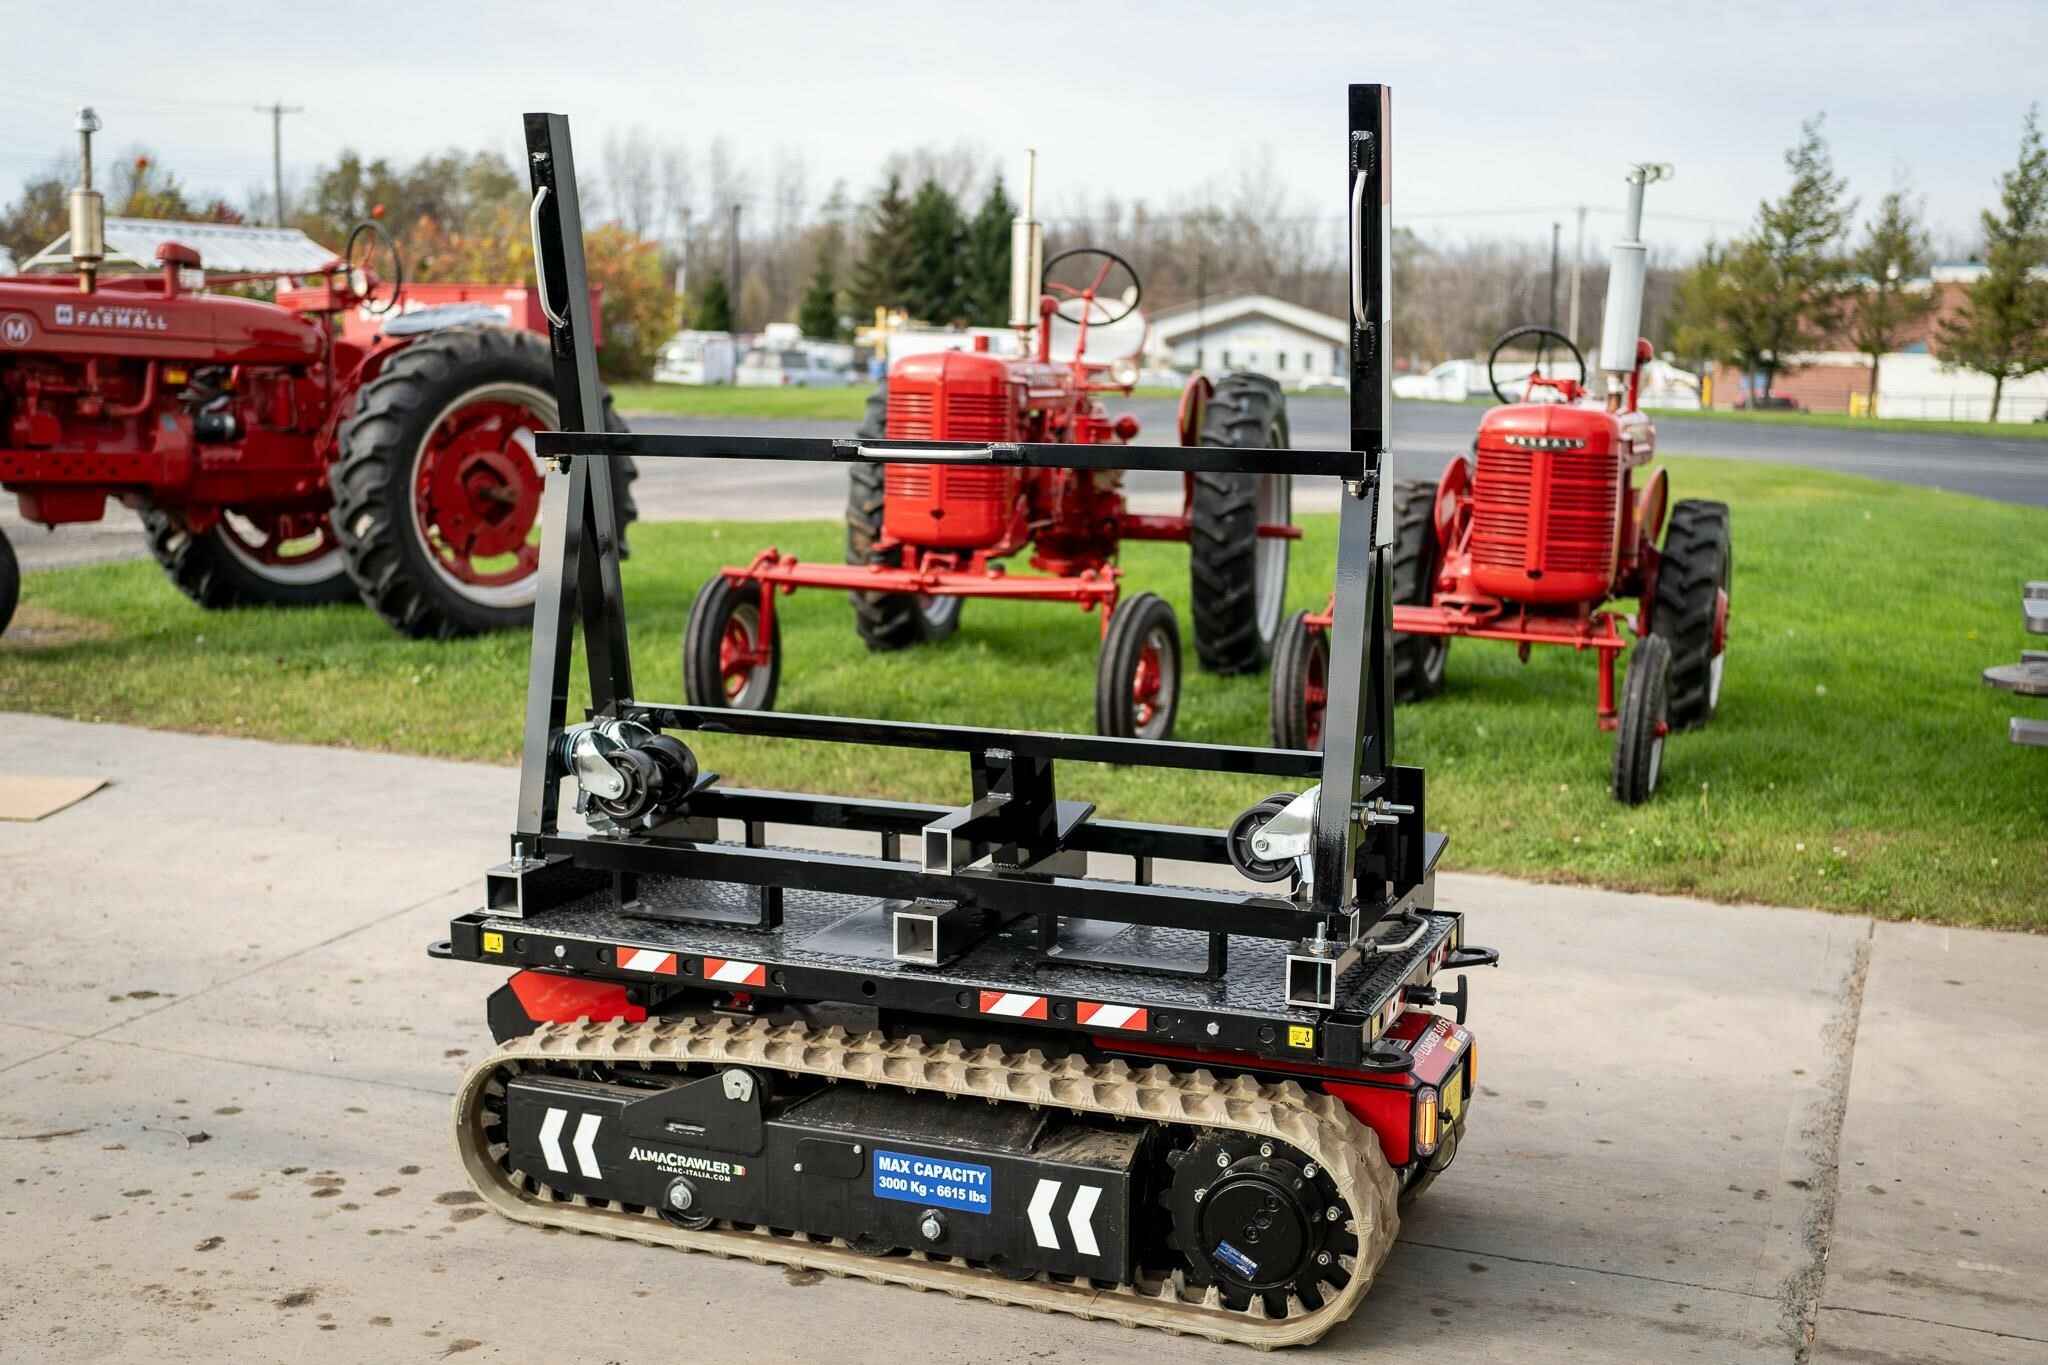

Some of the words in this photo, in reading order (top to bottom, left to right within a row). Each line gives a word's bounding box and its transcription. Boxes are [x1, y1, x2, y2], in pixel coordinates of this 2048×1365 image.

[77, 311, 168, 330] FARMALL
[6, 321, 26, 341] M
[657, 1164, 731, 1182] ALMAC-ITALIA.COM
[879, 1156, 911, 1174] MAX
[913, 1162, 986, 1185] CAPACITY
[879, 1175, 908, 1191] 3000
[910, 1181, 927, 1197] Kg
[936, 1185, 966, 1200] 6615
[968, 1190, 987, 1204] lbs
